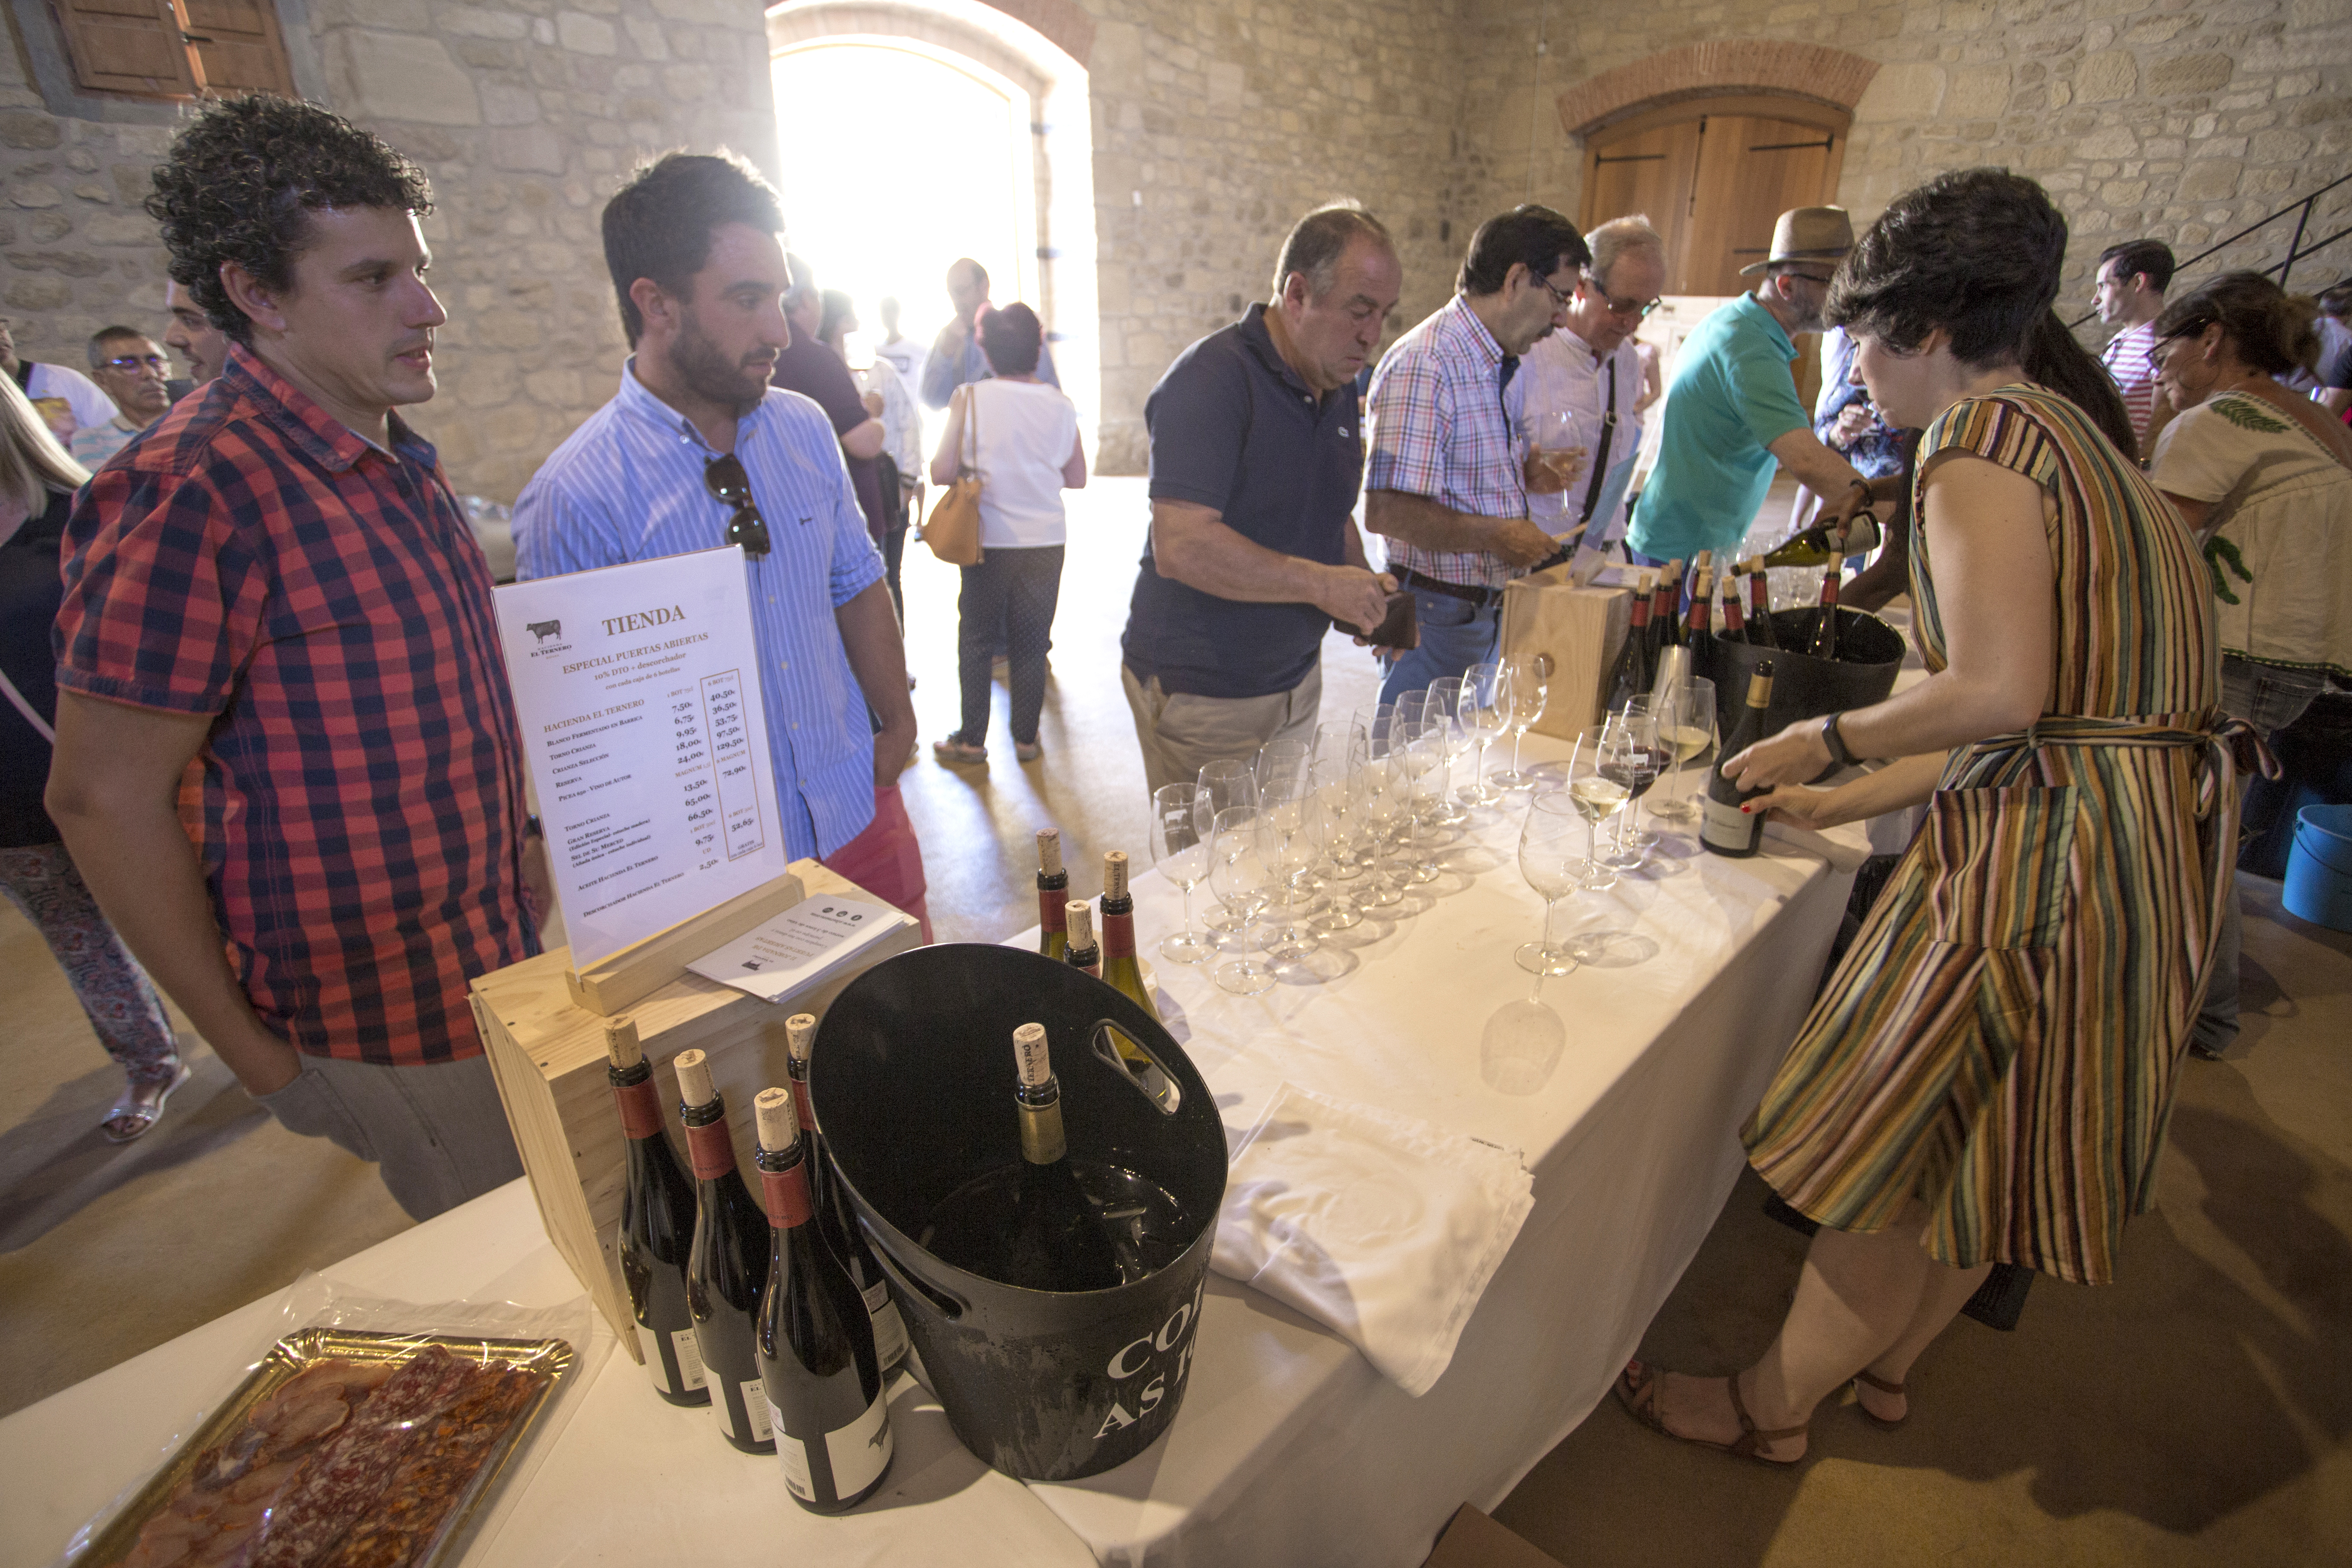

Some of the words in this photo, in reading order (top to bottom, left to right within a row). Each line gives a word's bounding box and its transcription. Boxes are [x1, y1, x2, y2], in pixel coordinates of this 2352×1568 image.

[602, 605, 686, 636] TIENDA
[541, 645, 572, 655] TERNERO
[563, 655, 614, 674] ESPECIAL
[616, 644, 661, 662] PUERTAS
[663, 632, 708, 649] ABIERTAS
[595, 671, 610, 680] 10%
[612, 667, 629, 676] DTO
[637, 652, 686, 669] descorchador
[618, 679, 632, 687] cada
[632, 675, 645, 684] caja
[658, 666, 680, 676] botellas
[710, 689, 735, 702] 40,50€
[671, 702, 693, 713] 7,50€
[712, 702, 737, 715] 36,50€
[544, 714, 591, 732] HACIENDA
[592, 710, 604, 719] EL
[605, 699, 644, 715] TERNERO
[674, 714, 695, 725] 6,75€
[715, 714, 738, 727] 53,75€
[547, 736, 571, 747] BLANCO
[571, 725, 609, 740] FERMENTADO
[619, 715, 643, 726] BARRICA
[676, 727, 697, 739] 9,95€
[717, 726, 741, 739] 97,50€
[676, 739, 702, 751] 18,00€
[717, 738, 744, 751] 129,50€
[549, 750, 570, 760] TORNO
[571, 743, 597, 754] CRIANZA
[677, 751, 704, 764] 24,00€
[720, 750, 746, 763] MAGNUM
[552, 763, 578, 775] CRIANZA
[675, 764, 702, 778] MAGNUM
[722, 766, 747, 779] 72,90€
[556, 776, 582, 788] RESERVA
[558, 792, 576, 802] PICEA
[613, 774, 631, 784] AUTOR
[684, 779, 708, 792] 13,50€
[685, 794, 711, 806] 65,00€
[688, 808, 713, 821] 66,50€
[732, 808, 744, 817] BOT
[564, 821, 585, 832] TORNO
[585, 813, 610, 824] CRIANZA
[693, 824, 705, 832] BOT
[732, 818, 754, 832] 52,65€
[567, 836, 584, 845] GRAN
[585, 827, 610, 839] RESERVA
[695, 834, 715, 846] 9,75€
[600, 838, 624, 850] MERCED
[738, 839, 754, 850] GRATIS
[699, 859, 719, 870] 2,50€
[578, 880, 598, 891] ACEITE
[598, 869, 626, 883] HACIENDA
[634, 856, 658, 868] TERNERO
[583, 897, 626, 918] DESCORCHADOR
[626, 885, 653, 899] HACIENDA
[661, 872, 684, 885] TERNERO
